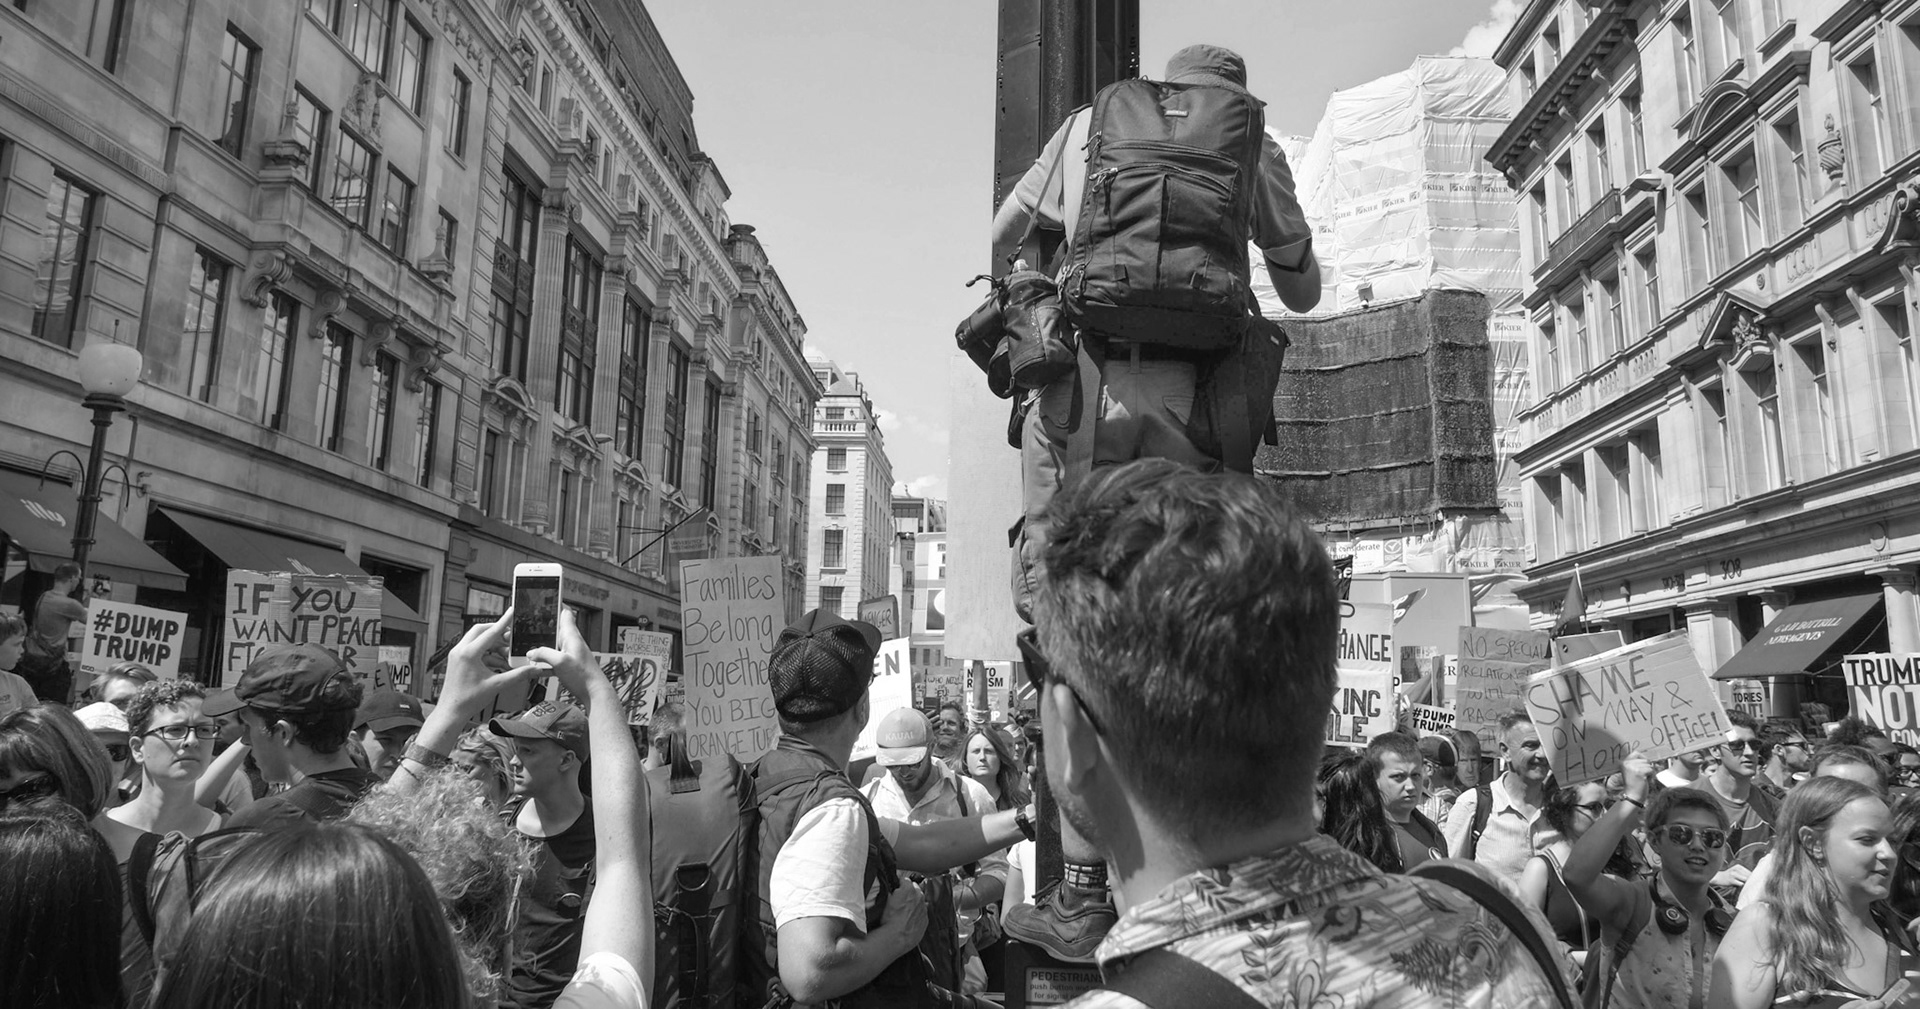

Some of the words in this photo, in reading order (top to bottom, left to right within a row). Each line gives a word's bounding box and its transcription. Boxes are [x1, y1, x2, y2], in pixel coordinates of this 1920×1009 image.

[1427, 184, 1444, 192] KIER
[1458, 185, 1477, 193] KIER
[1491, 186, 1509, 194] KIER
[1503, 324, 1522, 332] KIER
[1339, 543, 1380, 553] consderate
[1470, 560, 1489, 568] KIER
[1504, 560, 1522, 568] KIER
[1720, 557, 1742, 580] 308
[683, 564, 775, 603] Families
[232, 583, 275, 615] IF
[290, 585, 356, 614] YOU
[93, 609, 179, 642] #DUMP
[233, 615, 320, 645] WANT
[320, 615, 381, 647] PEACE
[684, 605, 775, 654] Belong
[93, 633, 171, 666] TRUMP
[1464, 634, 1487, 659] NO
[1495, 637, 1546, 659] SPECIAL
[685, 647, 770, 698] Togethe
[1528, 655, 1651, 725] SHAME
[728, 697, 776, 723] BIG
[1412, 707, 1456, 724] #DUMP
[1552, 720, 1586, 750] ON
[1604, 692, 1654, 729] MAY
[1665, 681, 1693, 709] &
[1735, 703, 1764, 718] OUT!
[688, 729, 749, 759] ORANGE
[1566, 740, 1640, 781] Home
[1651, 711, 1724, 751] OFFICE!
[1030, 983, 1048, 991] push
[1050, 983, 1074, 991] button
